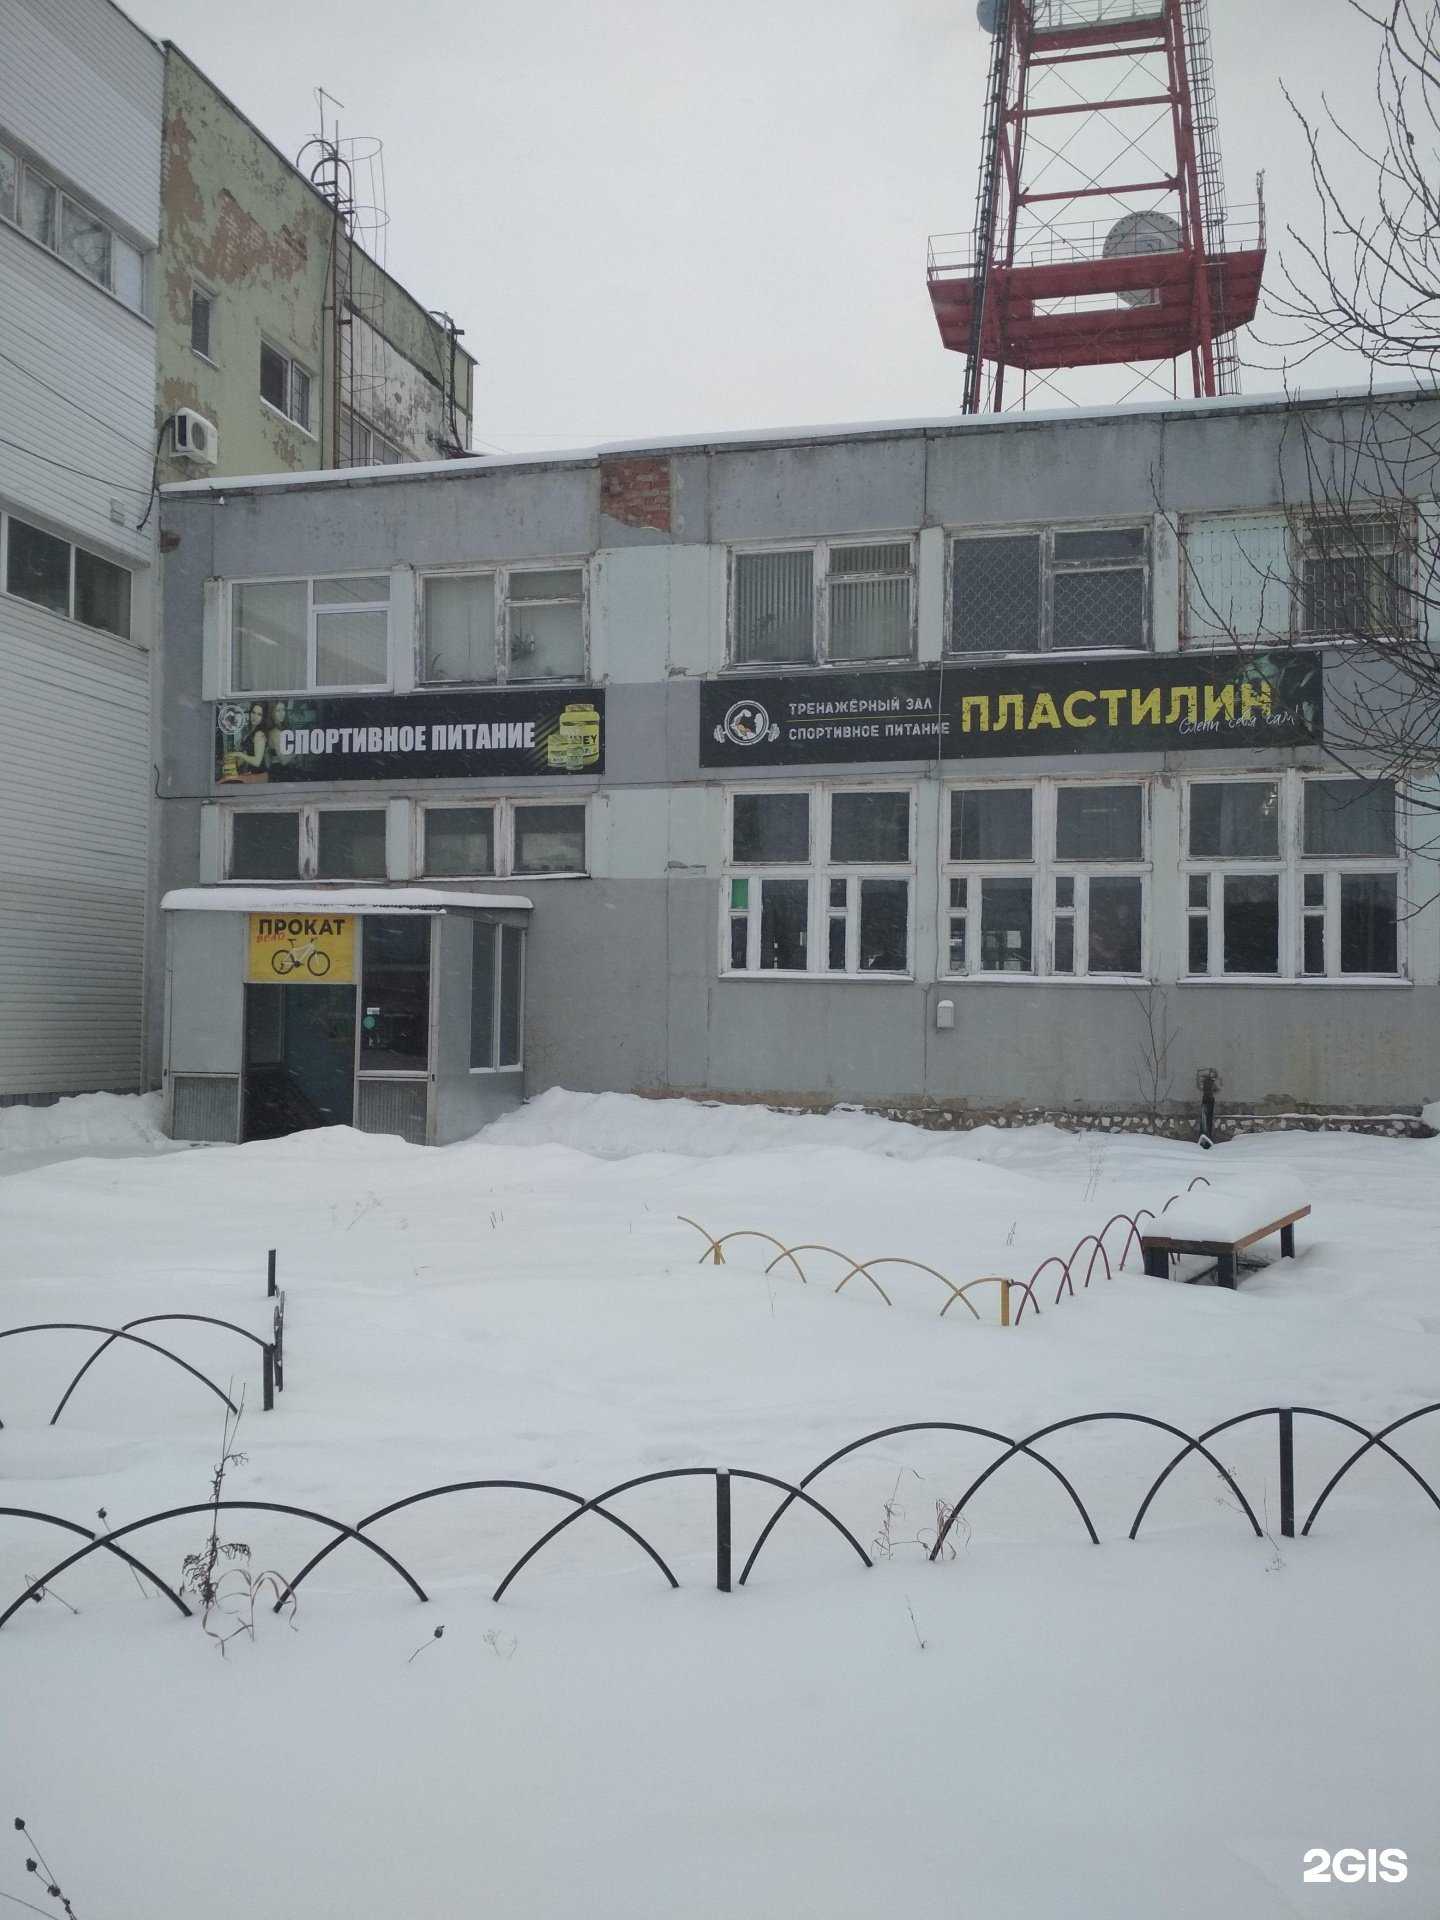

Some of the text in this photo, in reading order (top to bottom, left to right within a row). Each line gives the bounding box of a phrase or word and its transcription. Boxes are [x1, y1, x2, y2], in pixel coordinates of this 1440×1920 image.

[904, 697, 932, 711] ЗАЛ
[961, 685, 1273, 732] ПЛАСТИЛИН
[281, 722, 536, 756] СПОРТИВНОЕ ПИТАНИЕ
[788, 723, 950, 741] СПОРТИВНОЕ ПИТАНИЕ
[259, 919, 346, 935] ПРОКАТ
